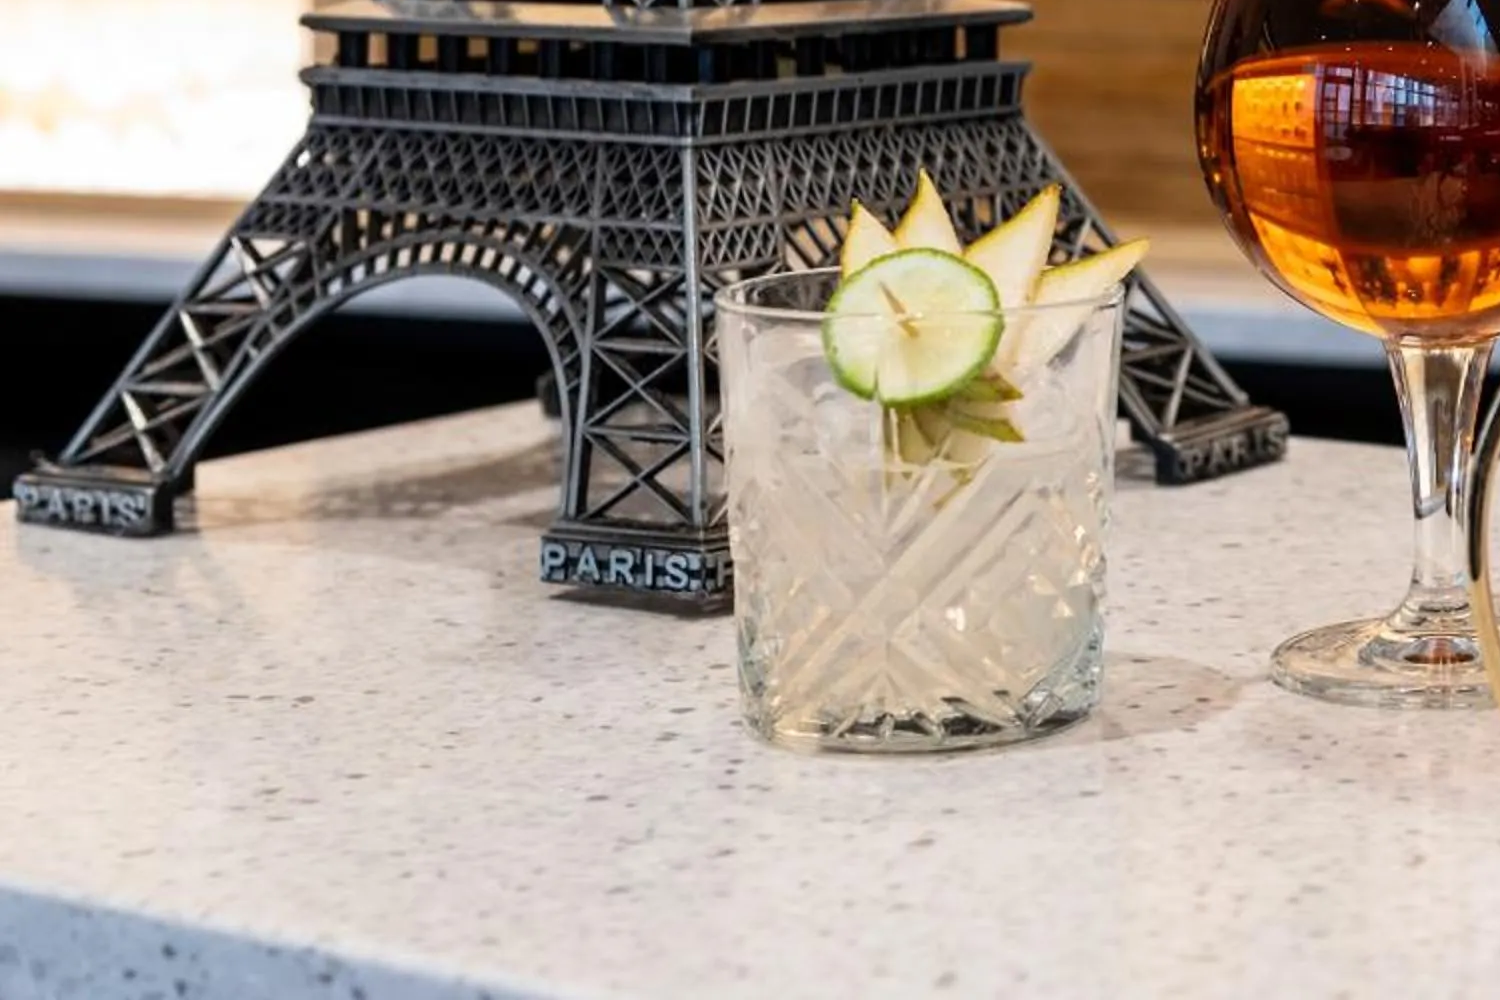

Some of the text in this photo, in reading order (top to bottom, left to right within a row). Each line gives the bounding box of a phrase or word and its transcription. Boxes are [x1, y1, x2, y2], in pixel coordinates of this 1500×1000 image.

[1180, 423, 1287, 478] PARIS
[13, 481, 142, 528] PARIS
[542, 543, 690, 590] PARIS
